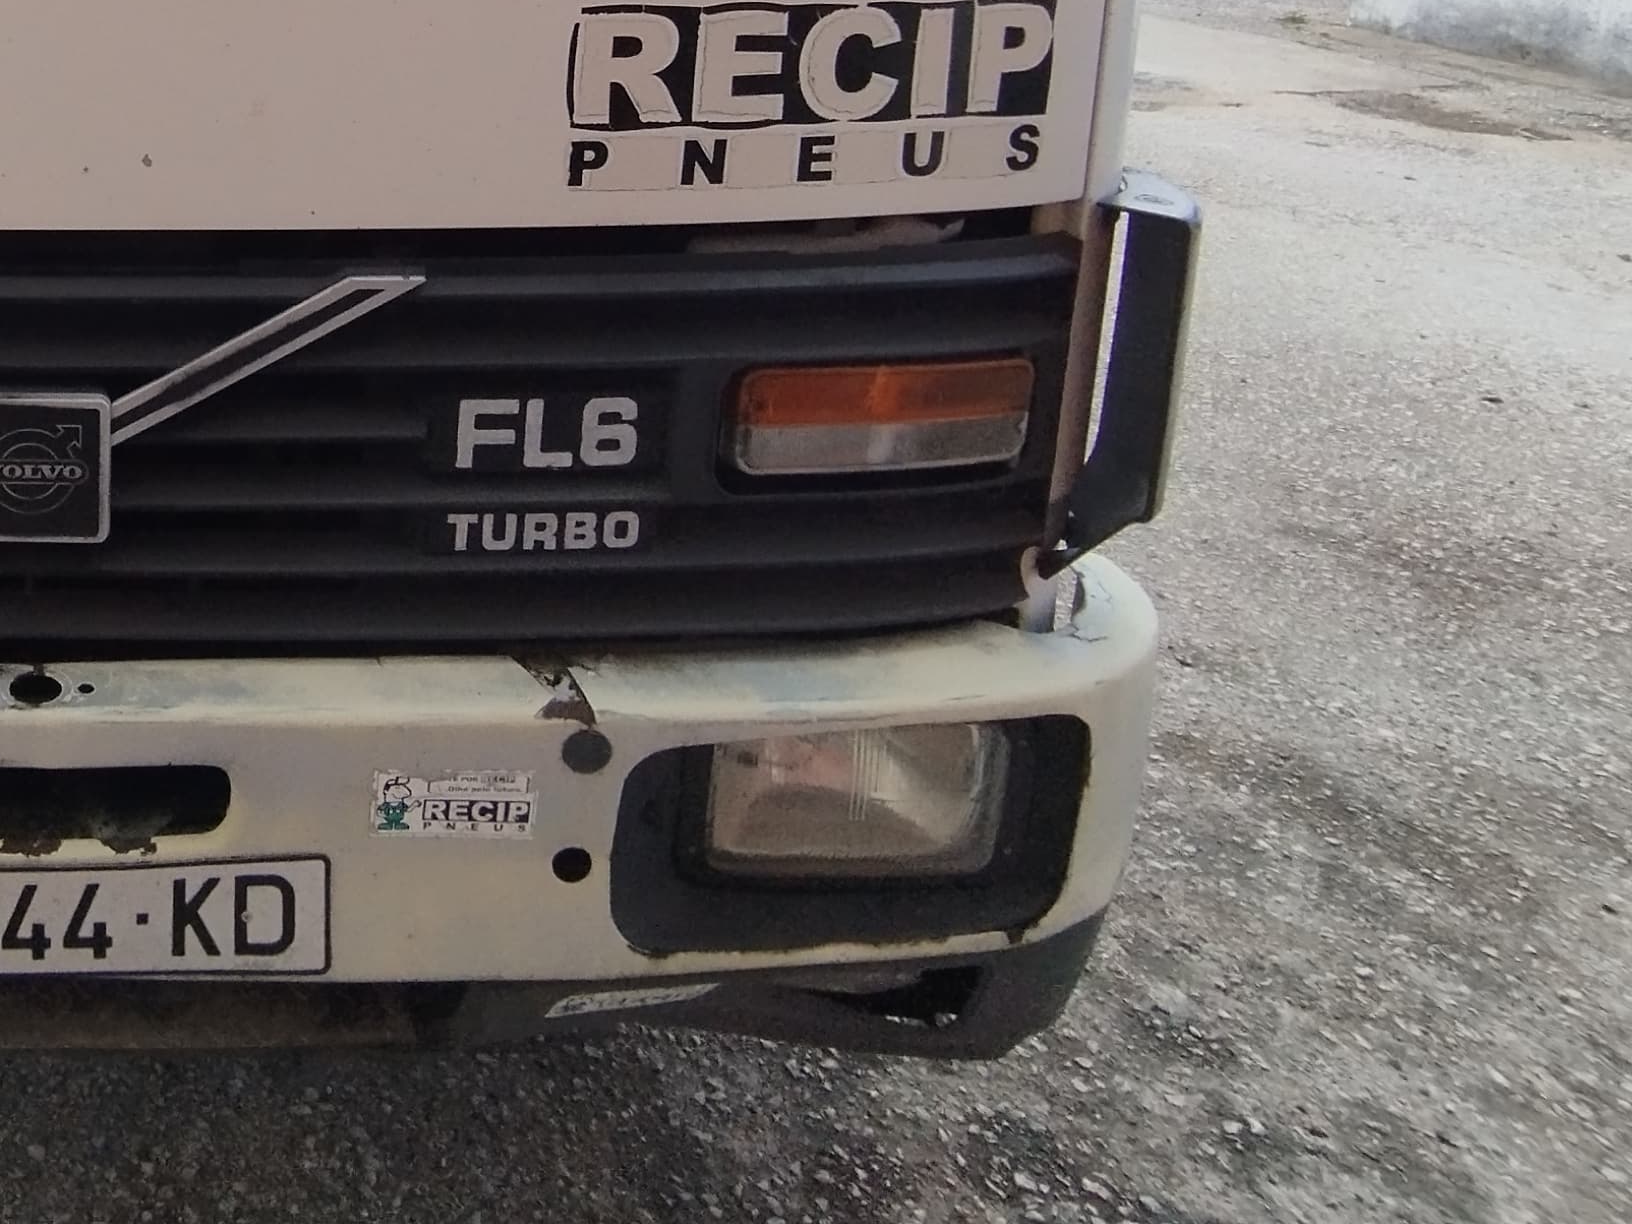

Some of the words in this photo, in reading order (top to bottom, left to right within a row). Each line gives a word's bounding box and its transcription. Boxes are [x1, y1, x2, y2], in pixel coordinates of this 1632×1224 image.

[568, 124, 1042, 186] PNEUS
[455, 396, 639, 469] FL6
[446, 510, 640, 552] TURBO
[423, 799, 531, 823] RECIP
[423, 822, 527, 832] PNEUS
